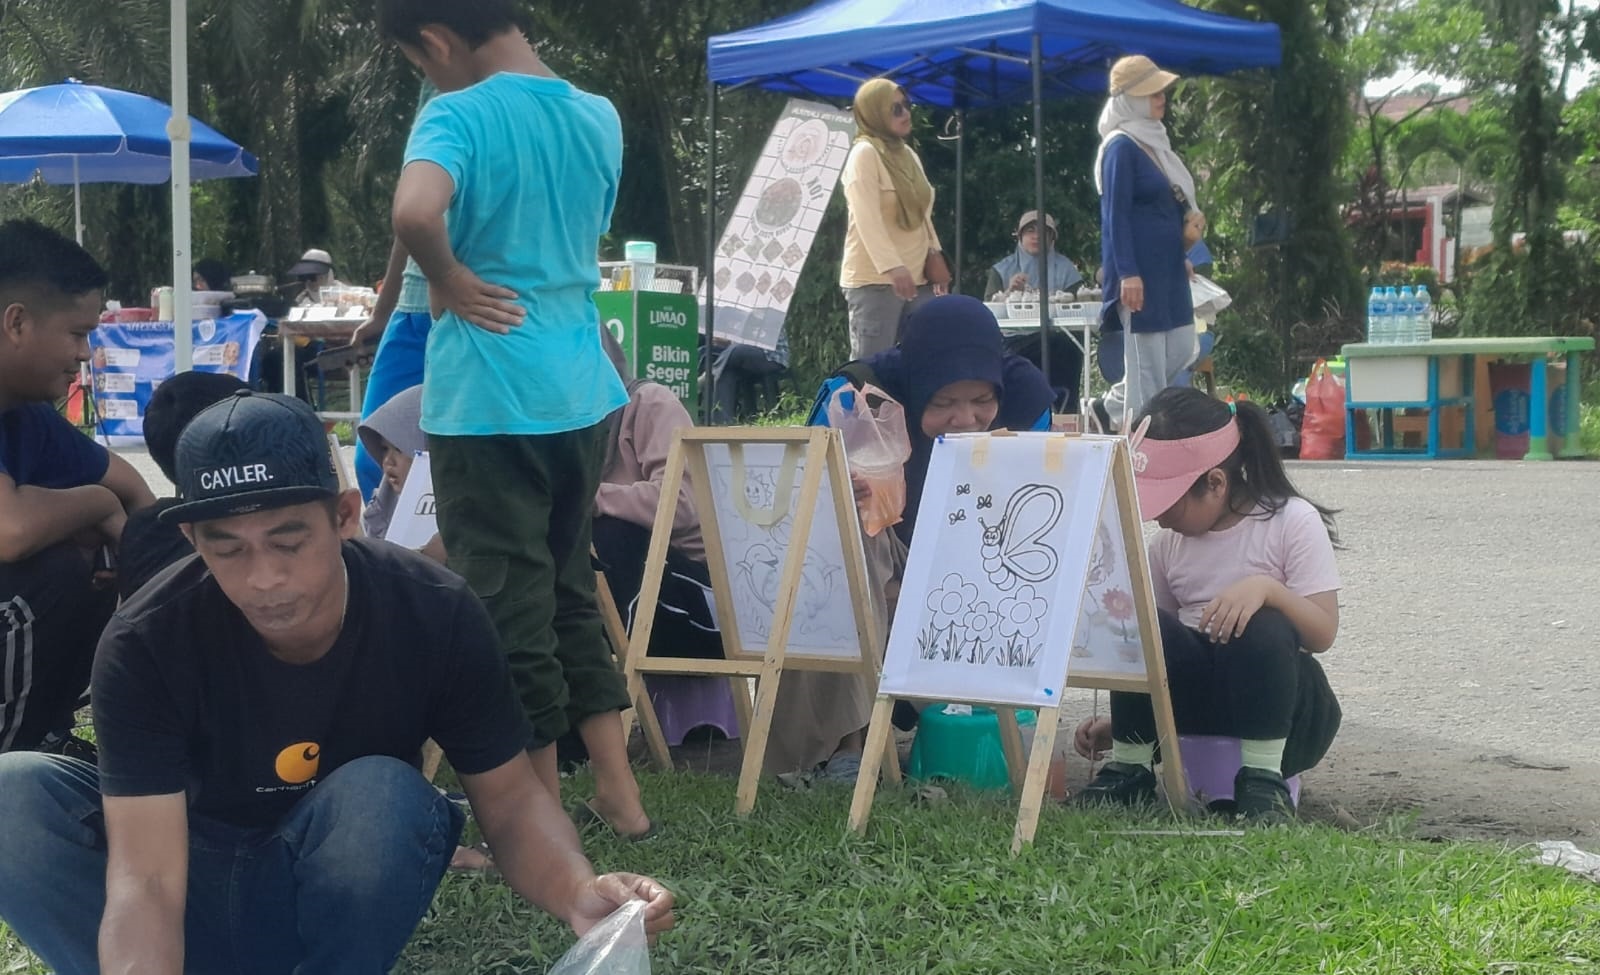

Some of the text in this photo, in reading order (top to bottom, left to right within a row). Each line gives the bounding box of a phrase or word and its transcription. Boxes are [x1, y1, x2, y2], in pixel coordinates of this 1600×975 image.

[650, 310, 687, 327] LIMAO
[652, 345, 690, 363] Bikin
[646, 363, 690, 383] Seger
